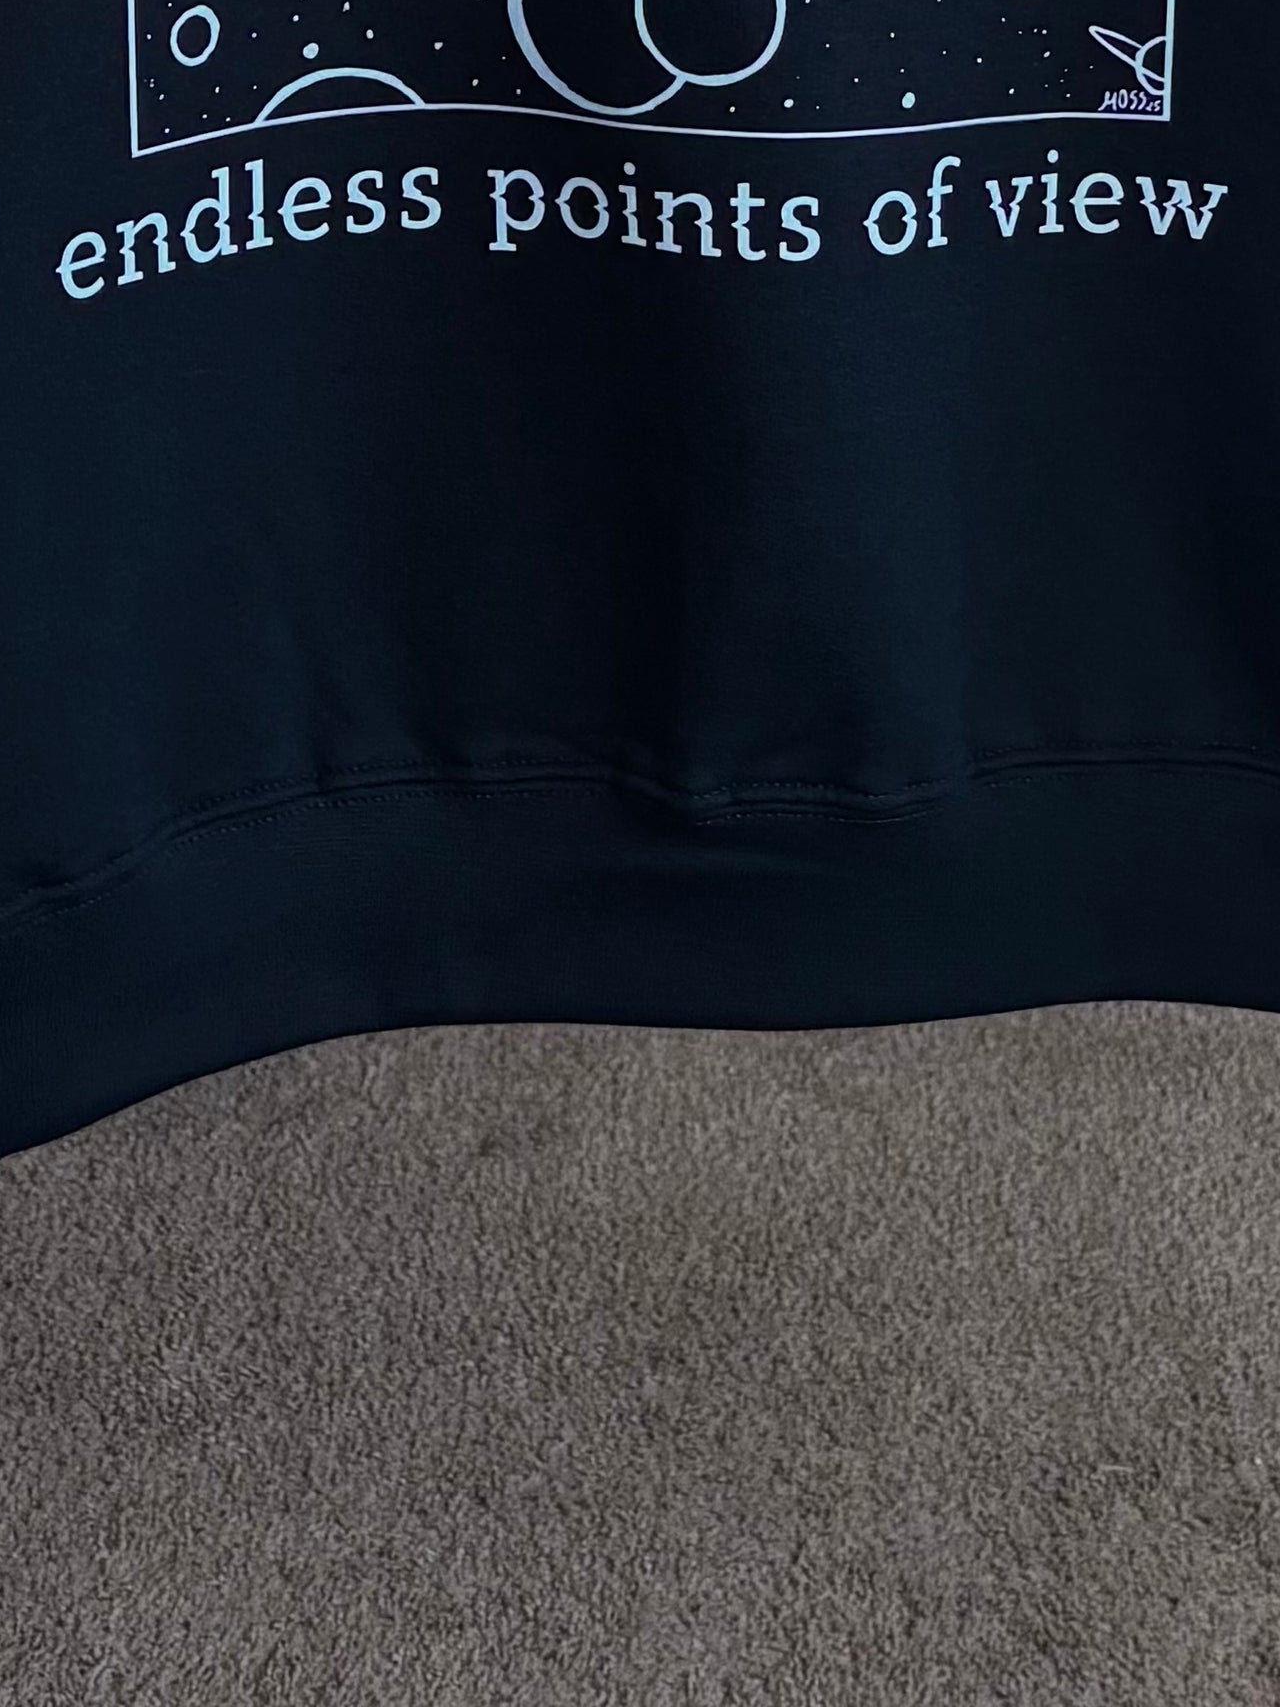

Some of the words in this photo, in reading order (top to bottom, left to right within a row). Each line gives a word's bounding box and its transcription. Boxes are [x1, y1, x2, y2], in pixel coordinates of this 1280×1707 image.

[1097, 88, 1148, 112] MOSS
[55, 158, 443, 300] endless
[486, 161, 822, 263] points
[862, 154, 962, 256] of
[984, 148, 1229, 241] view
